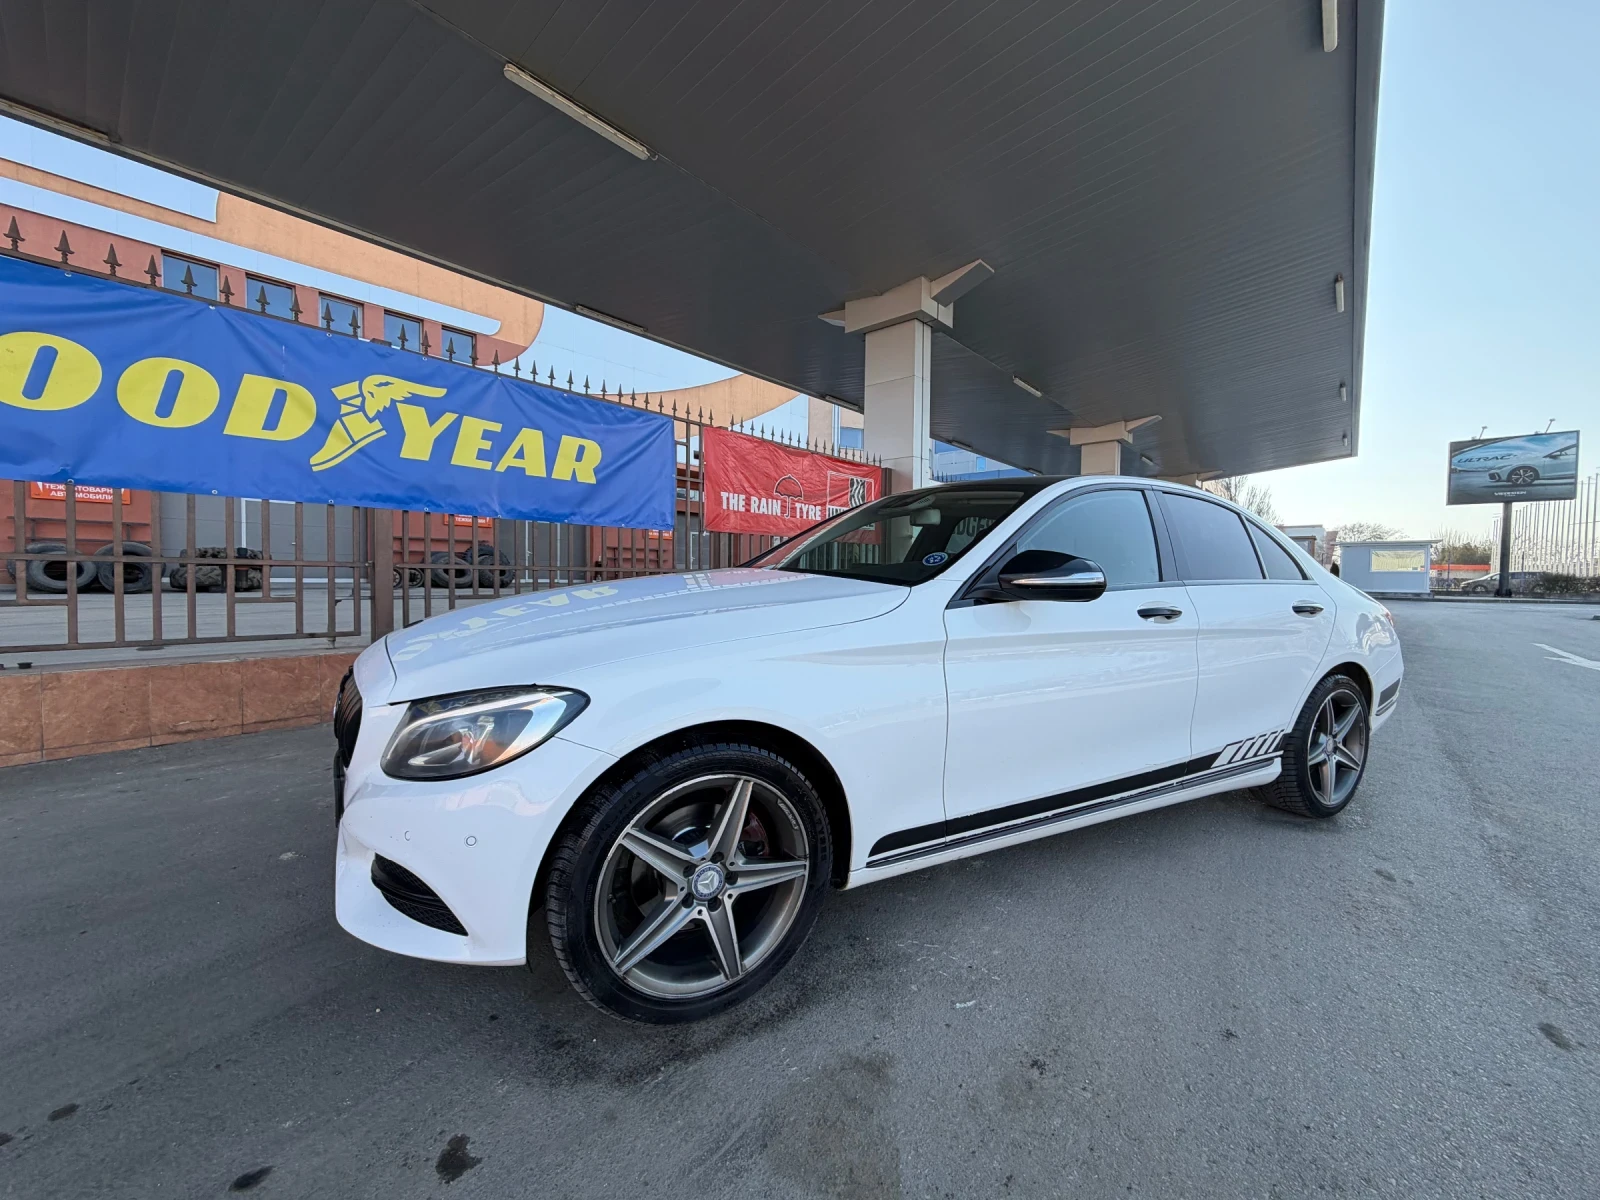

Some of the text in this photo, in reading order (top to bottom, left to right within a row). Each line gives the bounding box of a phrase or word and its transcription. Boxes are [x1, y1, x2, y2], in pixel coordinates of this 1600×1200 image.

[396, 402, 603, 485] YEAR
[50, 490, 113, 500] АВТМОБИЛИ
[721, 491, 746, 512] THE
[750, 496, 781, 517] RAIN
[795, 503, 822, 521] TYRE
